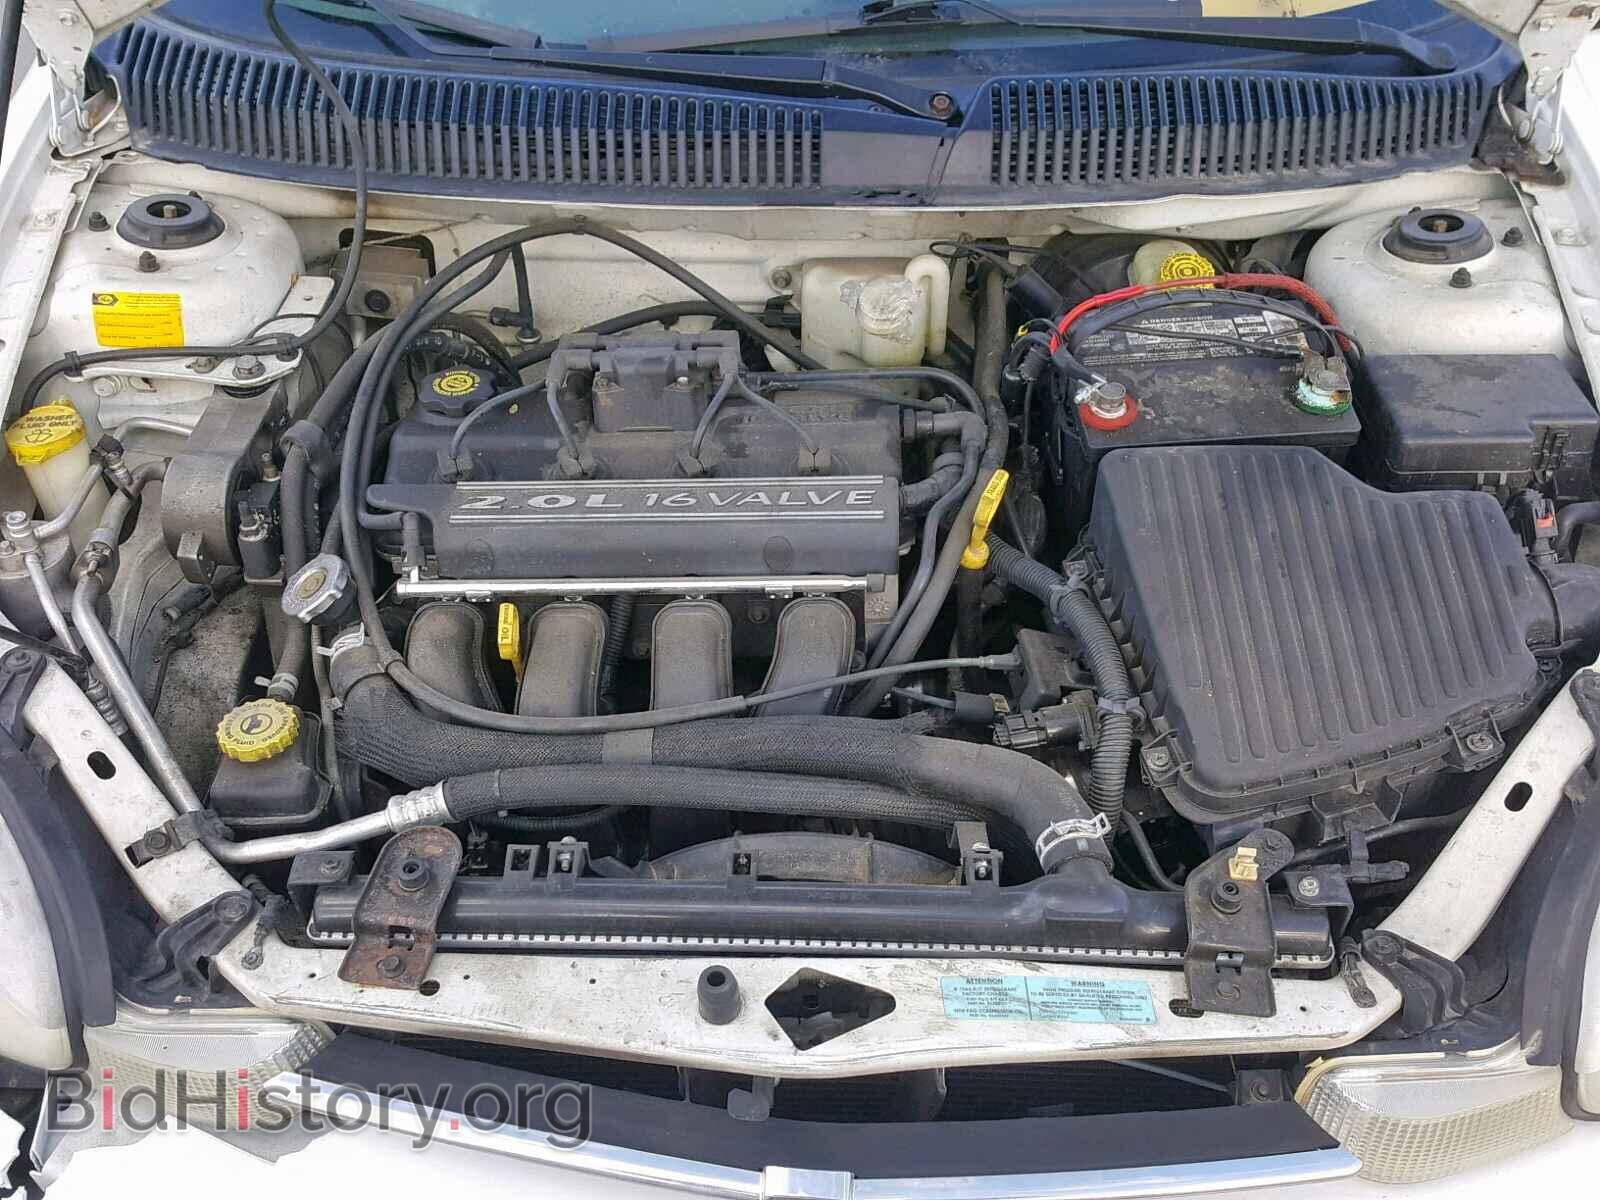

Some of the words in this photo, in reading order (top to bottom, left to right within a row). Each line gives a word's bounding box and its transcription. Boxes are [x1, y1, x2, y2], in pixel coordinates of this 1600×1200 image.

[25, 414, 73, 422] WASHER
[48, 420, 77, 428] ONLY
[459, 494, 624, 509] 2.0L
[644, 492, 697, 507] 16
[708, 489, 877, 506] VALVE
